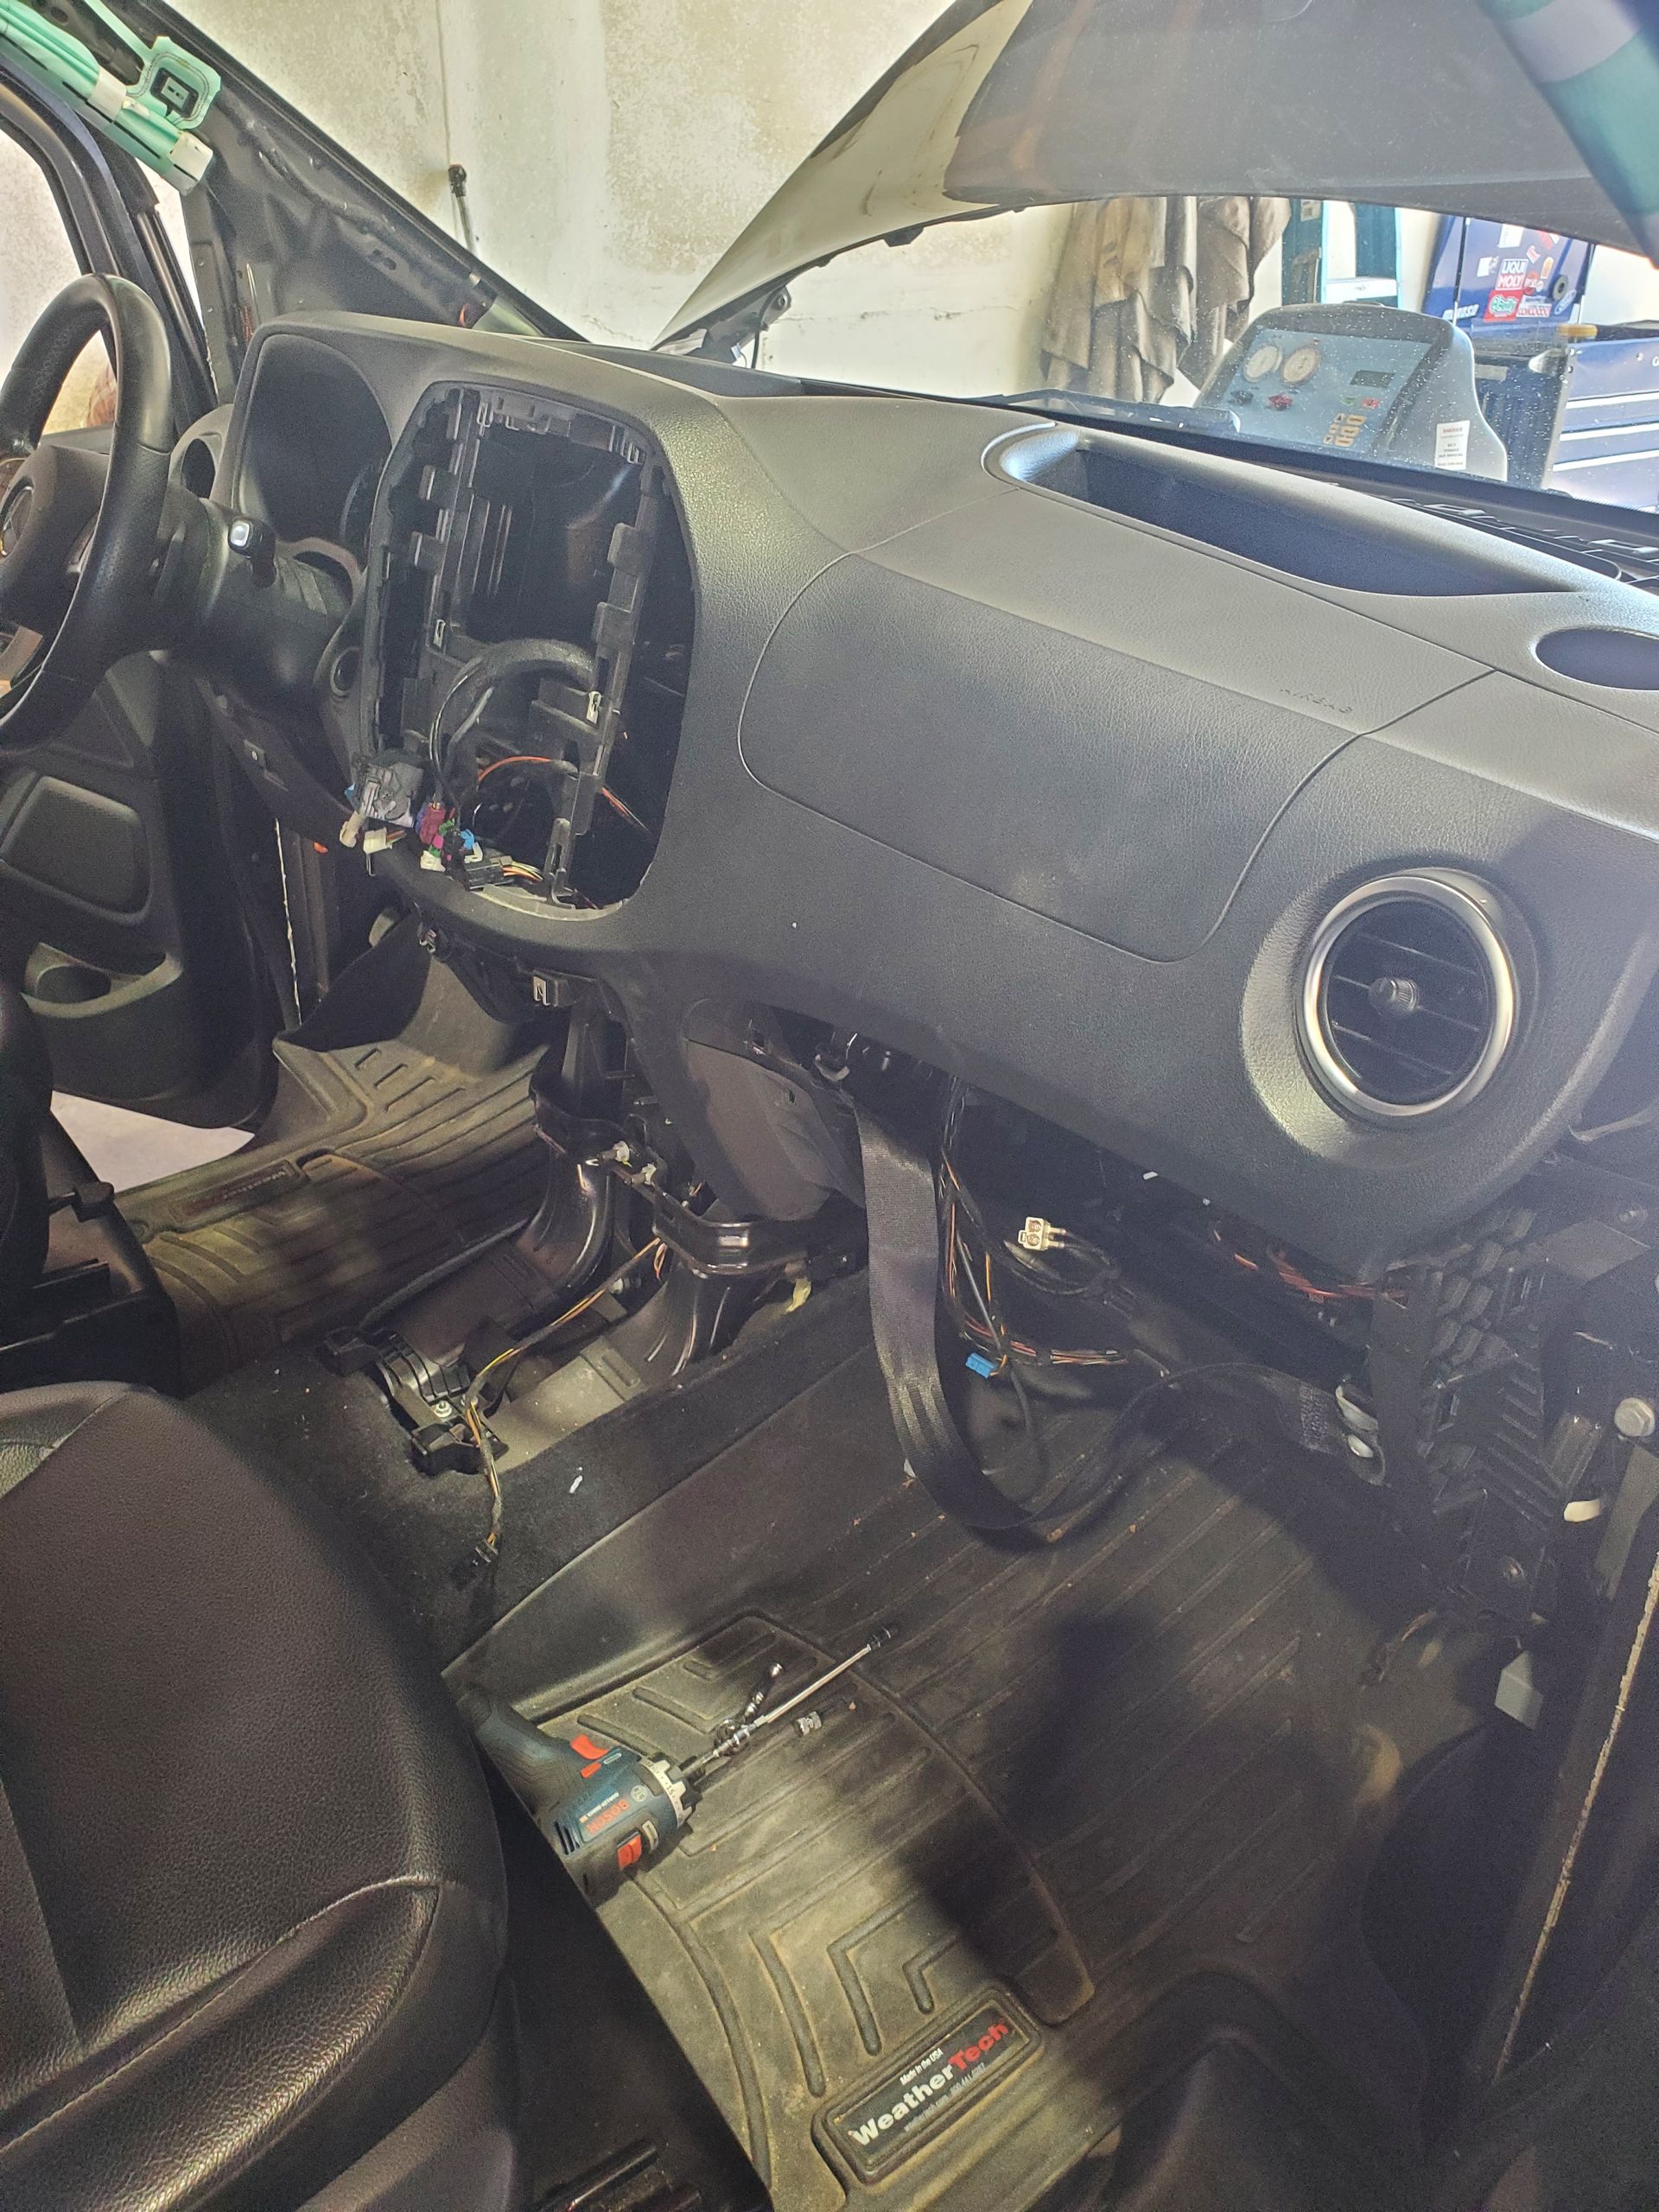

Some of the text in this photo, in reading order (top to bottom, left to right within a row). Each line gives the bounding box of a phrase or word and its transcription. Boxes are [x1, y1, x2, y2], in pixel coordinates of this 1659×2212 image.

[1497, 275, 1522, 288] MOLY
[1503, 260, 1527, 274] LIQUI
[586, 1799, 629, 1834] BOSCH
[852, 2023, 1008, 2145] WeatherTech
[899, 2070, 918, 2086] Made
[920, 2057, 931, 2070] the
[929, 2048, 944, 2063] USA
